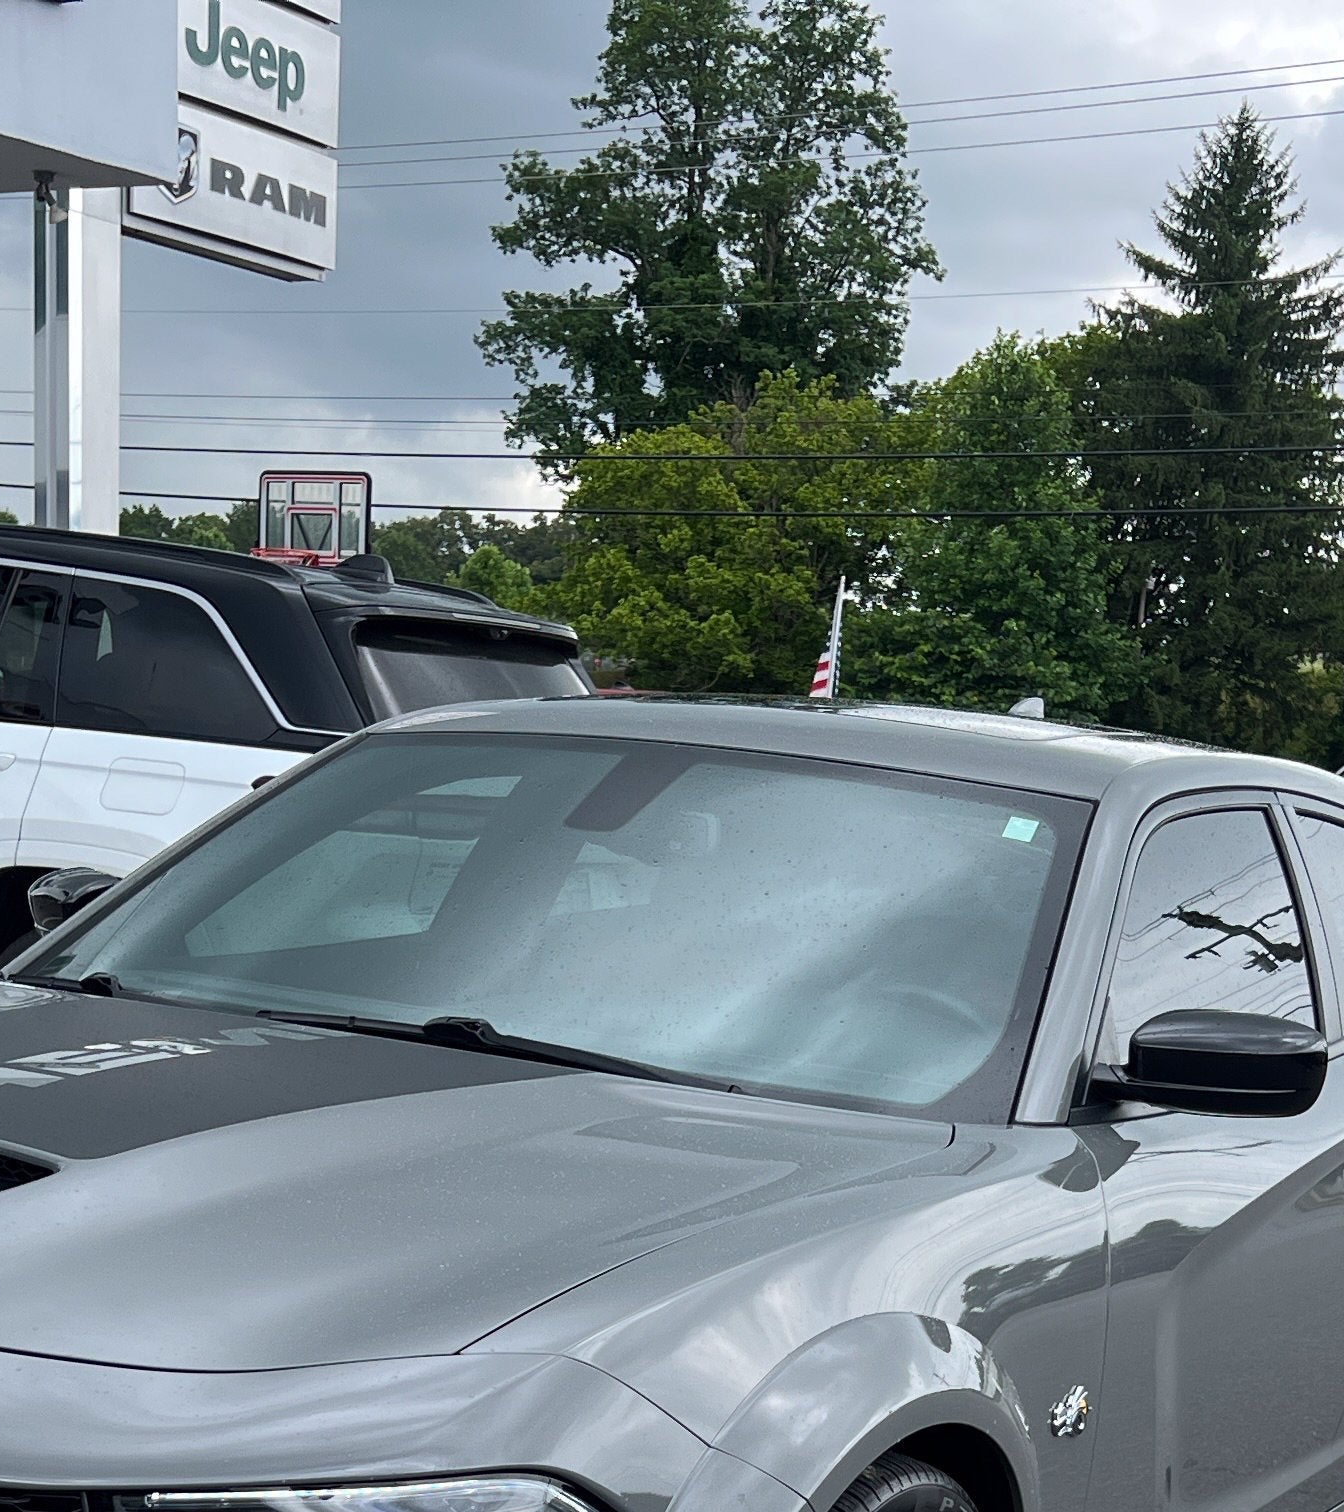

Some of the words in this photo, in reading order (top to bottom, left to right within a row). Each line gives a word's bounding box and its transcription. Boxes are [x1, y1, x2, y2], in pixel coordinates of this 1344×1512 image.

[185, 0, 305, 112] Jeep
[210, 157, 327, 228] RAM
[938, 1496, 955, 1512] P
